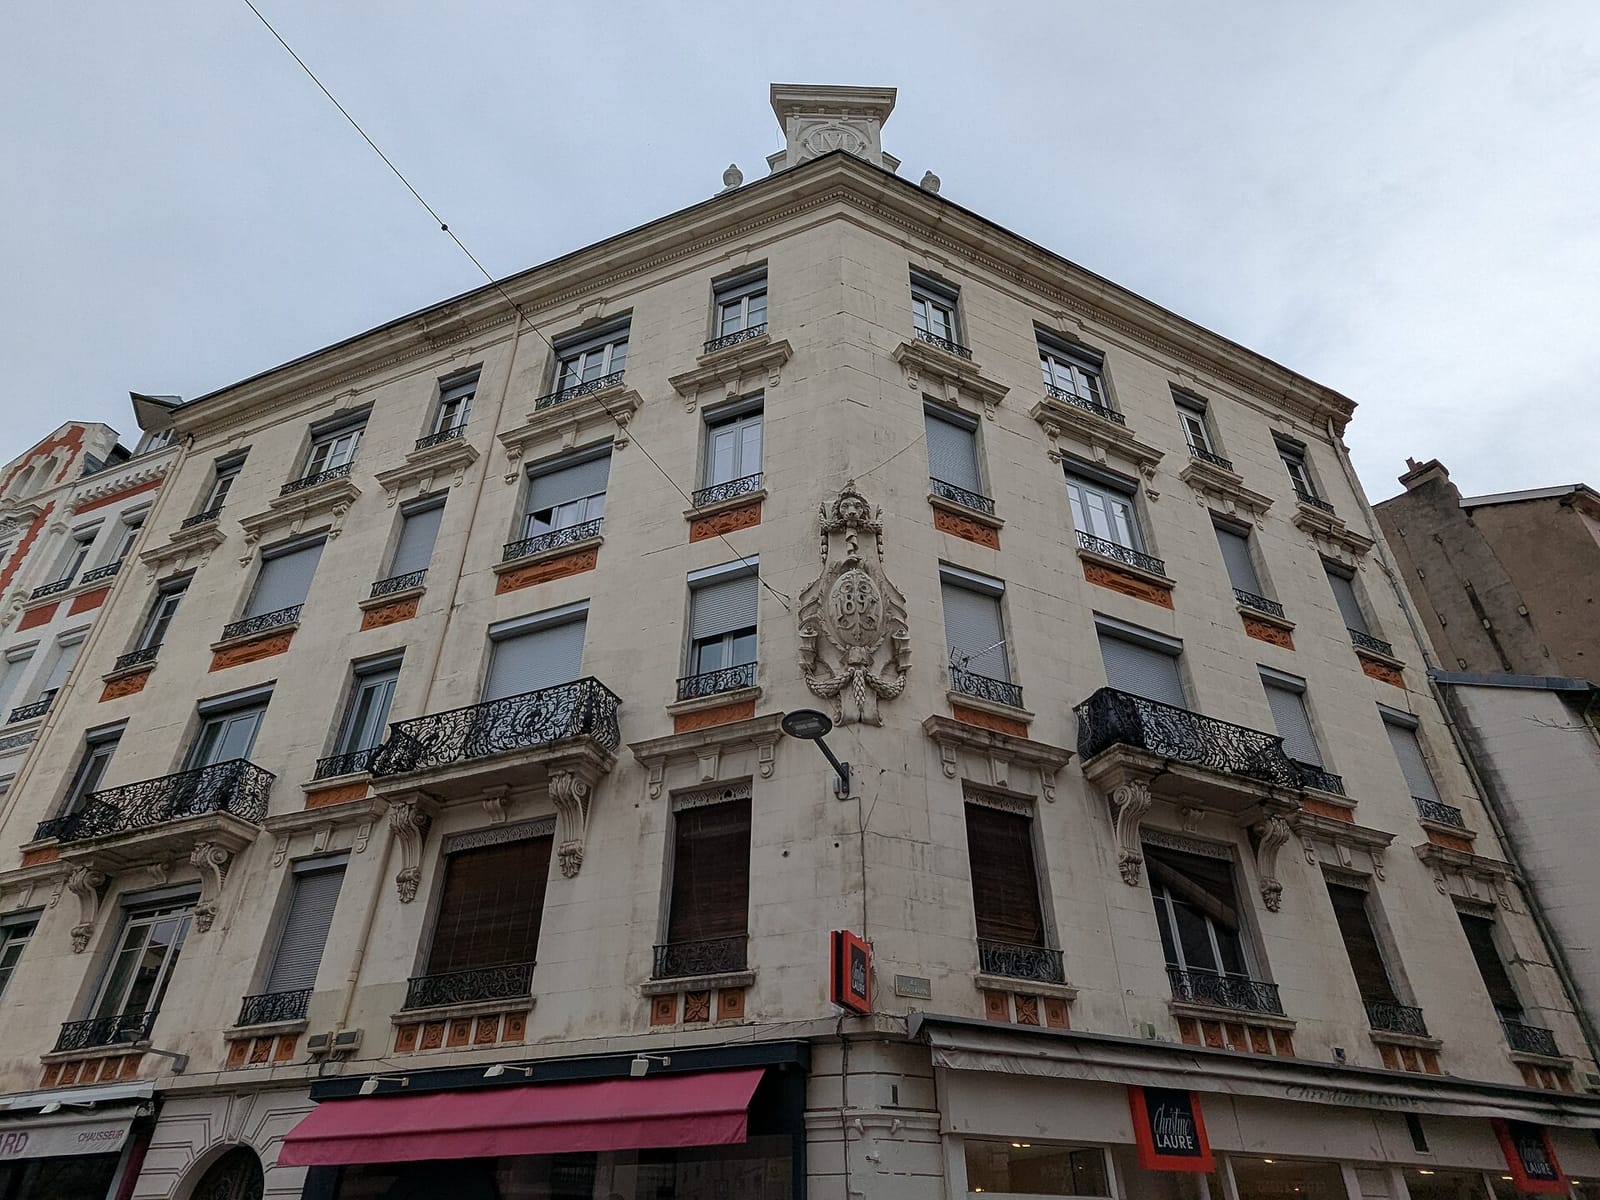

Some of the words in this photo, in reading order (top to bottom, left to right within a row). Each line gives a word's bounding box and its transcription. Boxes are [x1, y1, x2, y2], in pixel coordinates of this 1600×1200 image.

[1153, 1103, 1191, 1136] Christine
[0, 1132, 29, 1153] RD
[78, 1129, 125, 1143] CHAUSSEUR
[1156, 1134, 1194, 1150] LAURE
[1523, 1161, 1553, 1176] LAURE
